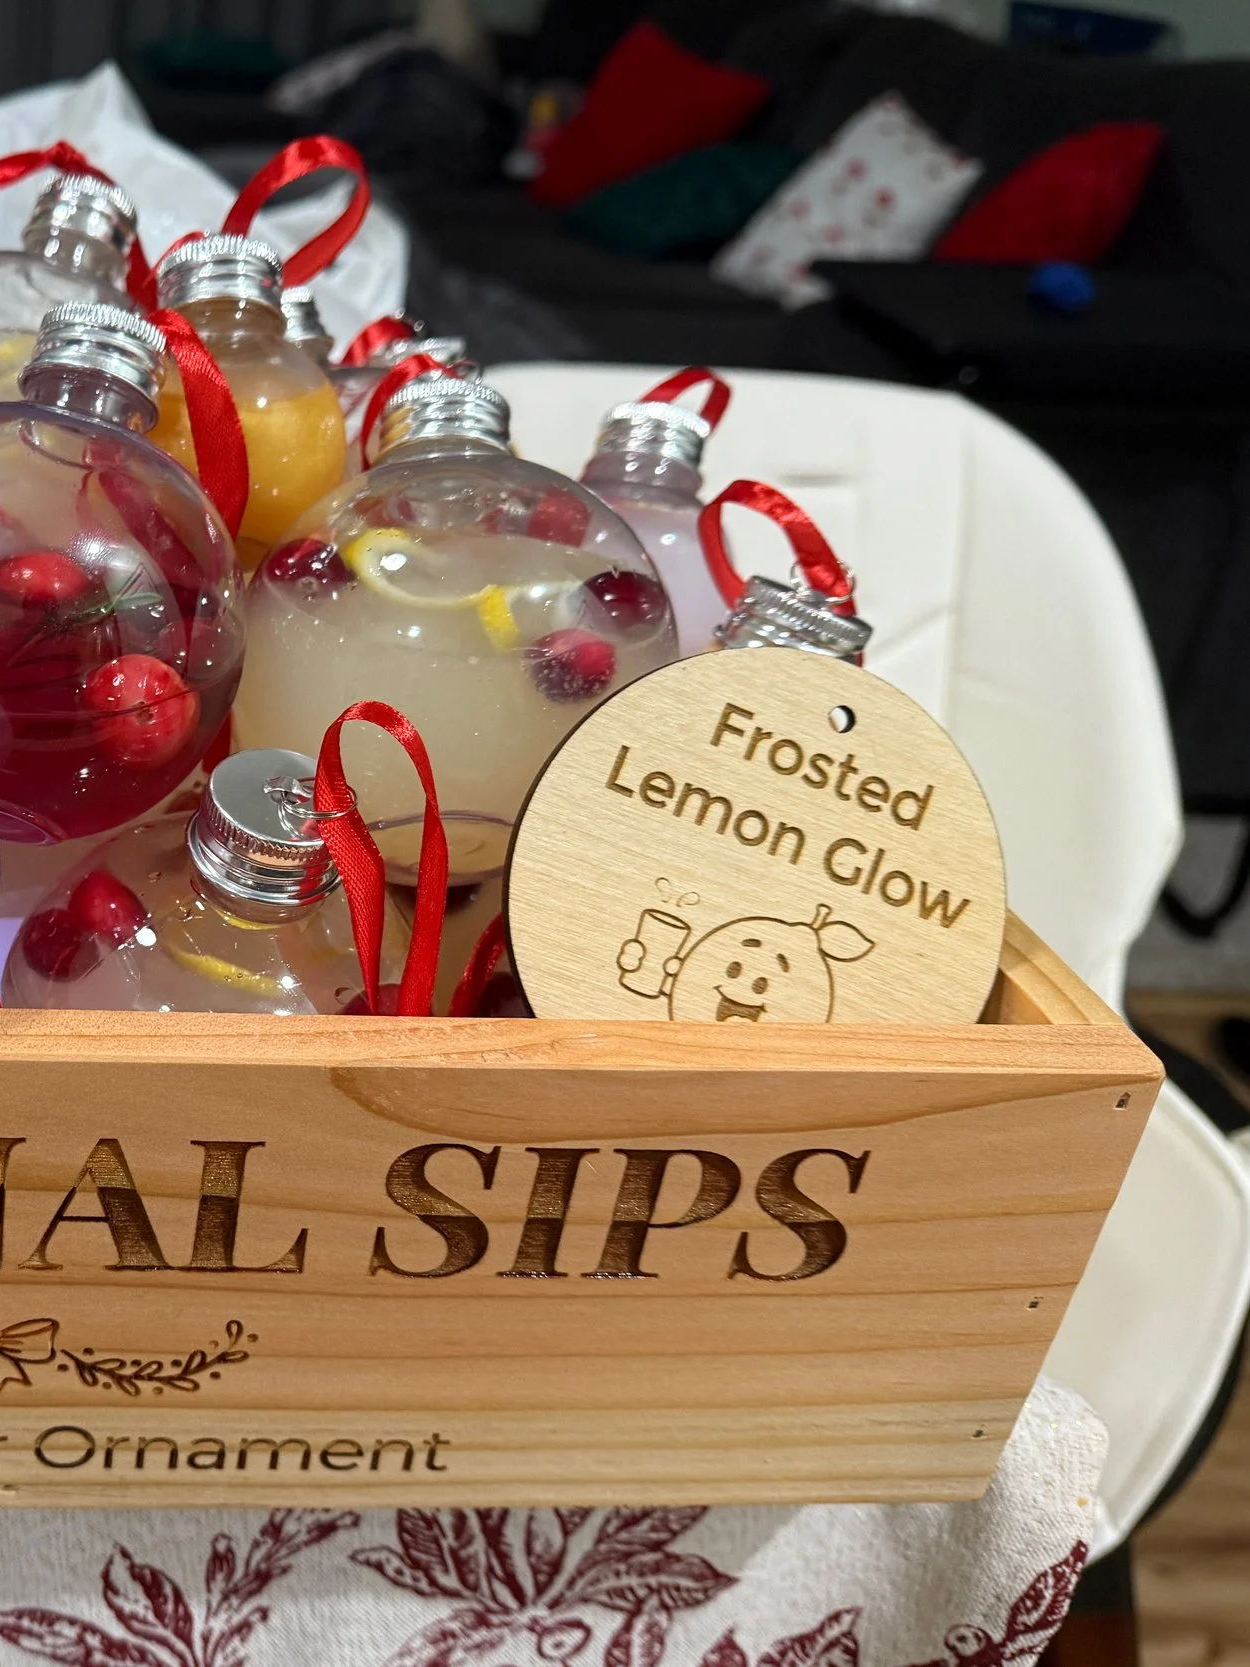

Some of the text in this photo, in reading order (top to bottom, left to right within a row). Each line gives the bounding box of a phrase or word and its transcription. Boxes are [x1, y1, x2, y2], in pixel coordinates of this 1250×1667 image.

[709, 702, 934, 830] Frosted
[605, 745, 972, 928] Lemon Glow
[369, 1142, 872, 1281] SIPS
[34, 1424, 450, 1472] Ornament
